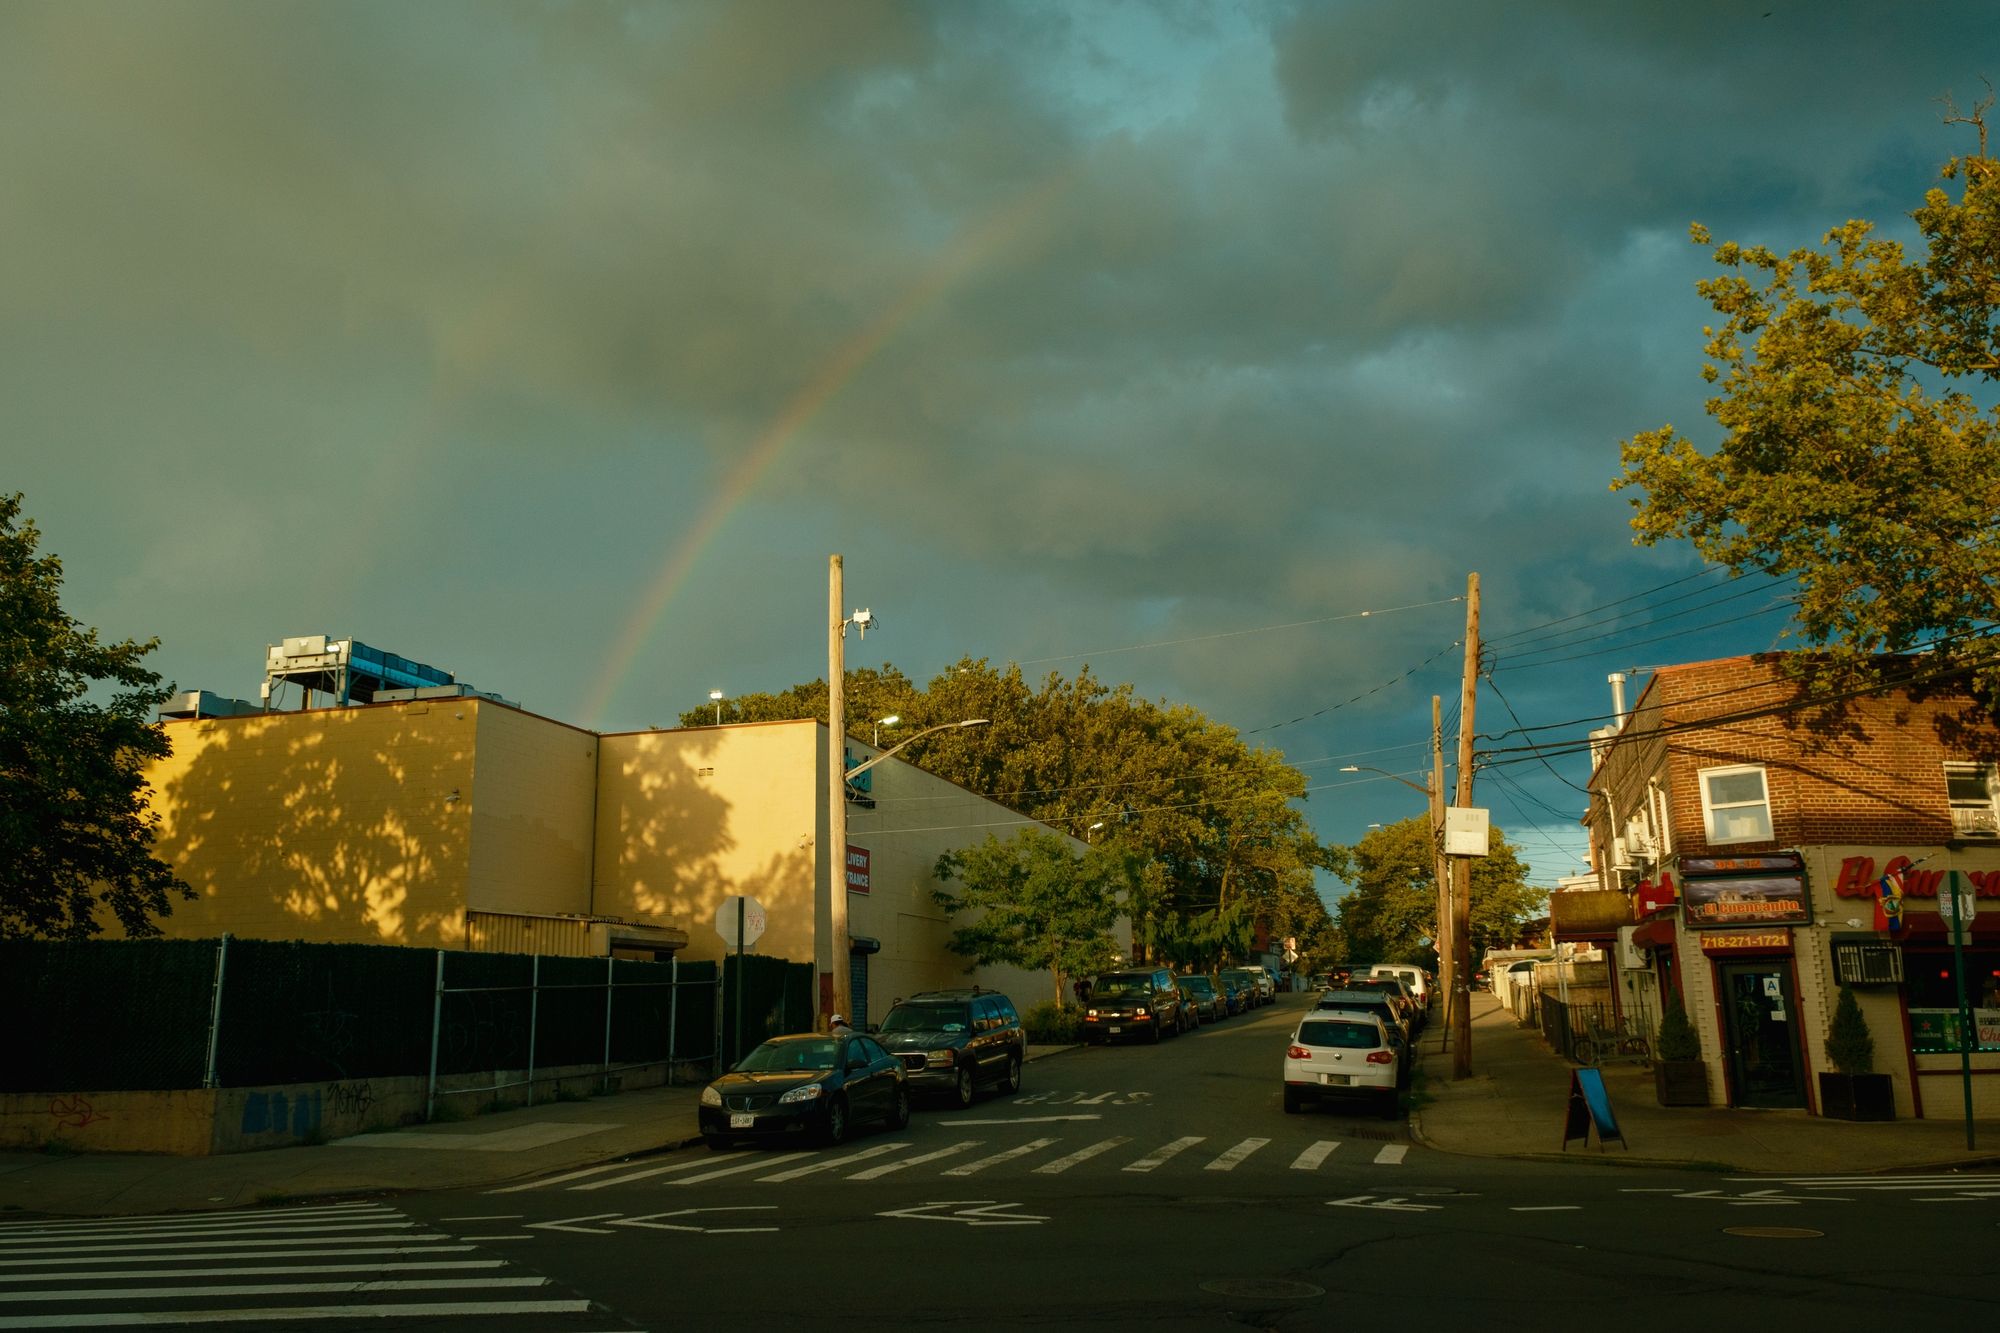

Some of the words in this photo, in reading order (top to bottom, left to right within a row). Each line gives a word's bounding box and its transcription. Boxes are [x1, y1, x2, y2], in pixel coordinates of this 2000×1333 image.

[1833, 856, 1879, 897] El
[1704, 903, 1717, 914] El
[1719, 900, 1799, 913] Cuencanito
[1702, 935, 1788, 947] 718-271-1721
[1768, 980, 1777, 990] A
